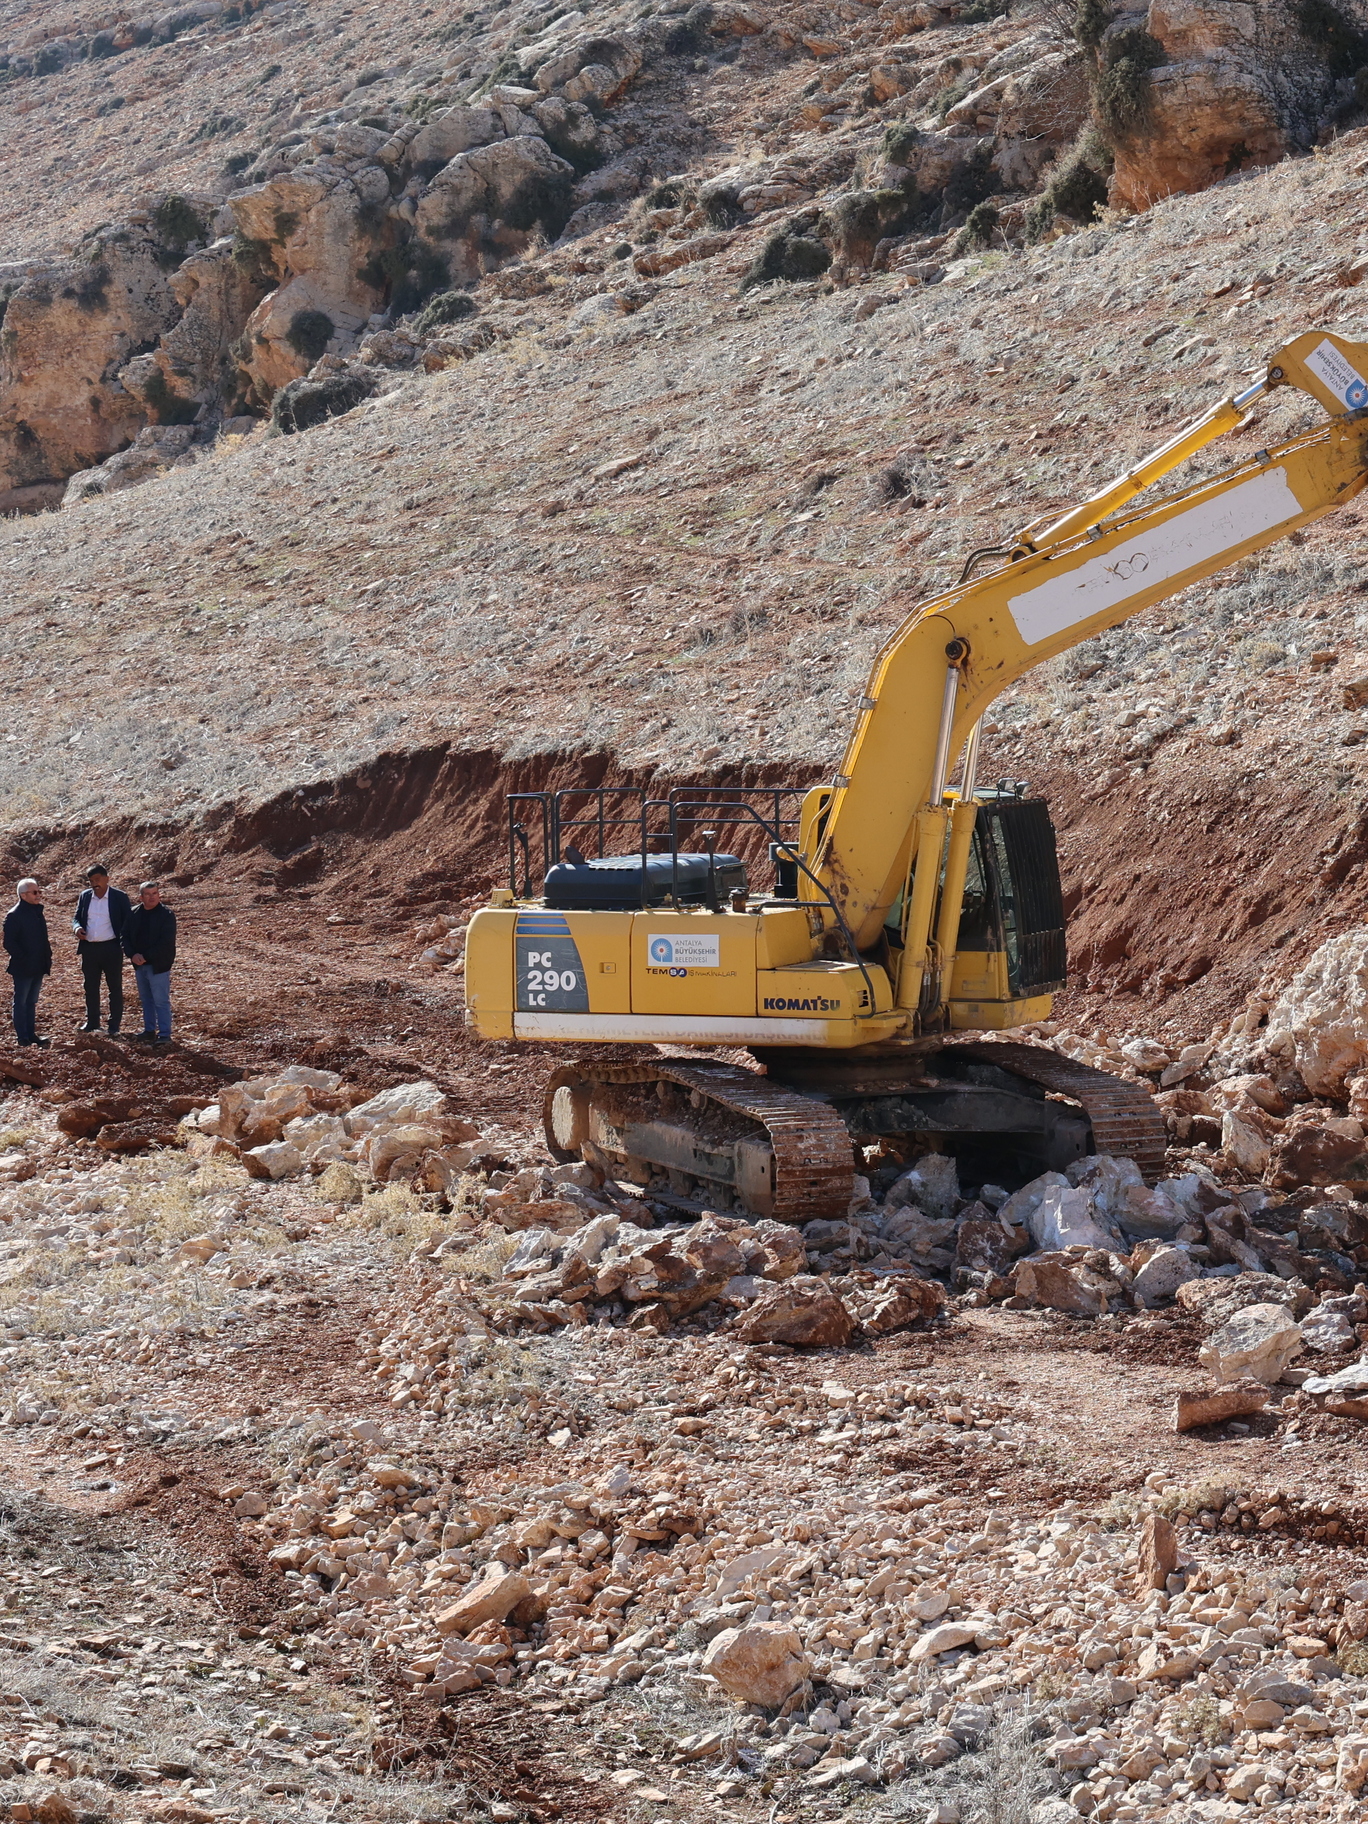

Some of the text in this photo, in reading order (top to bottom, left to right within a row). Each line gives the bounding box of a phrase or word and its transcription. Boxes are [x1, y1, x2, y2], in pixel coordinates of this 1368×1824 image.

[1328, 350, 1356, 380] BELEDİYESİ
[1321, 366, 1344, 391] ANTALYA
[674, 946, 717, 956] BÜYÜKŞEHİR
[527, 951, 552, 968] PC
[527, 970, 577, 991] 290
[646, 967, 688, 978] TEMSA
[528, 993, 546, 1006] LC
[763, 995, 841, 1011] KOMATSU
